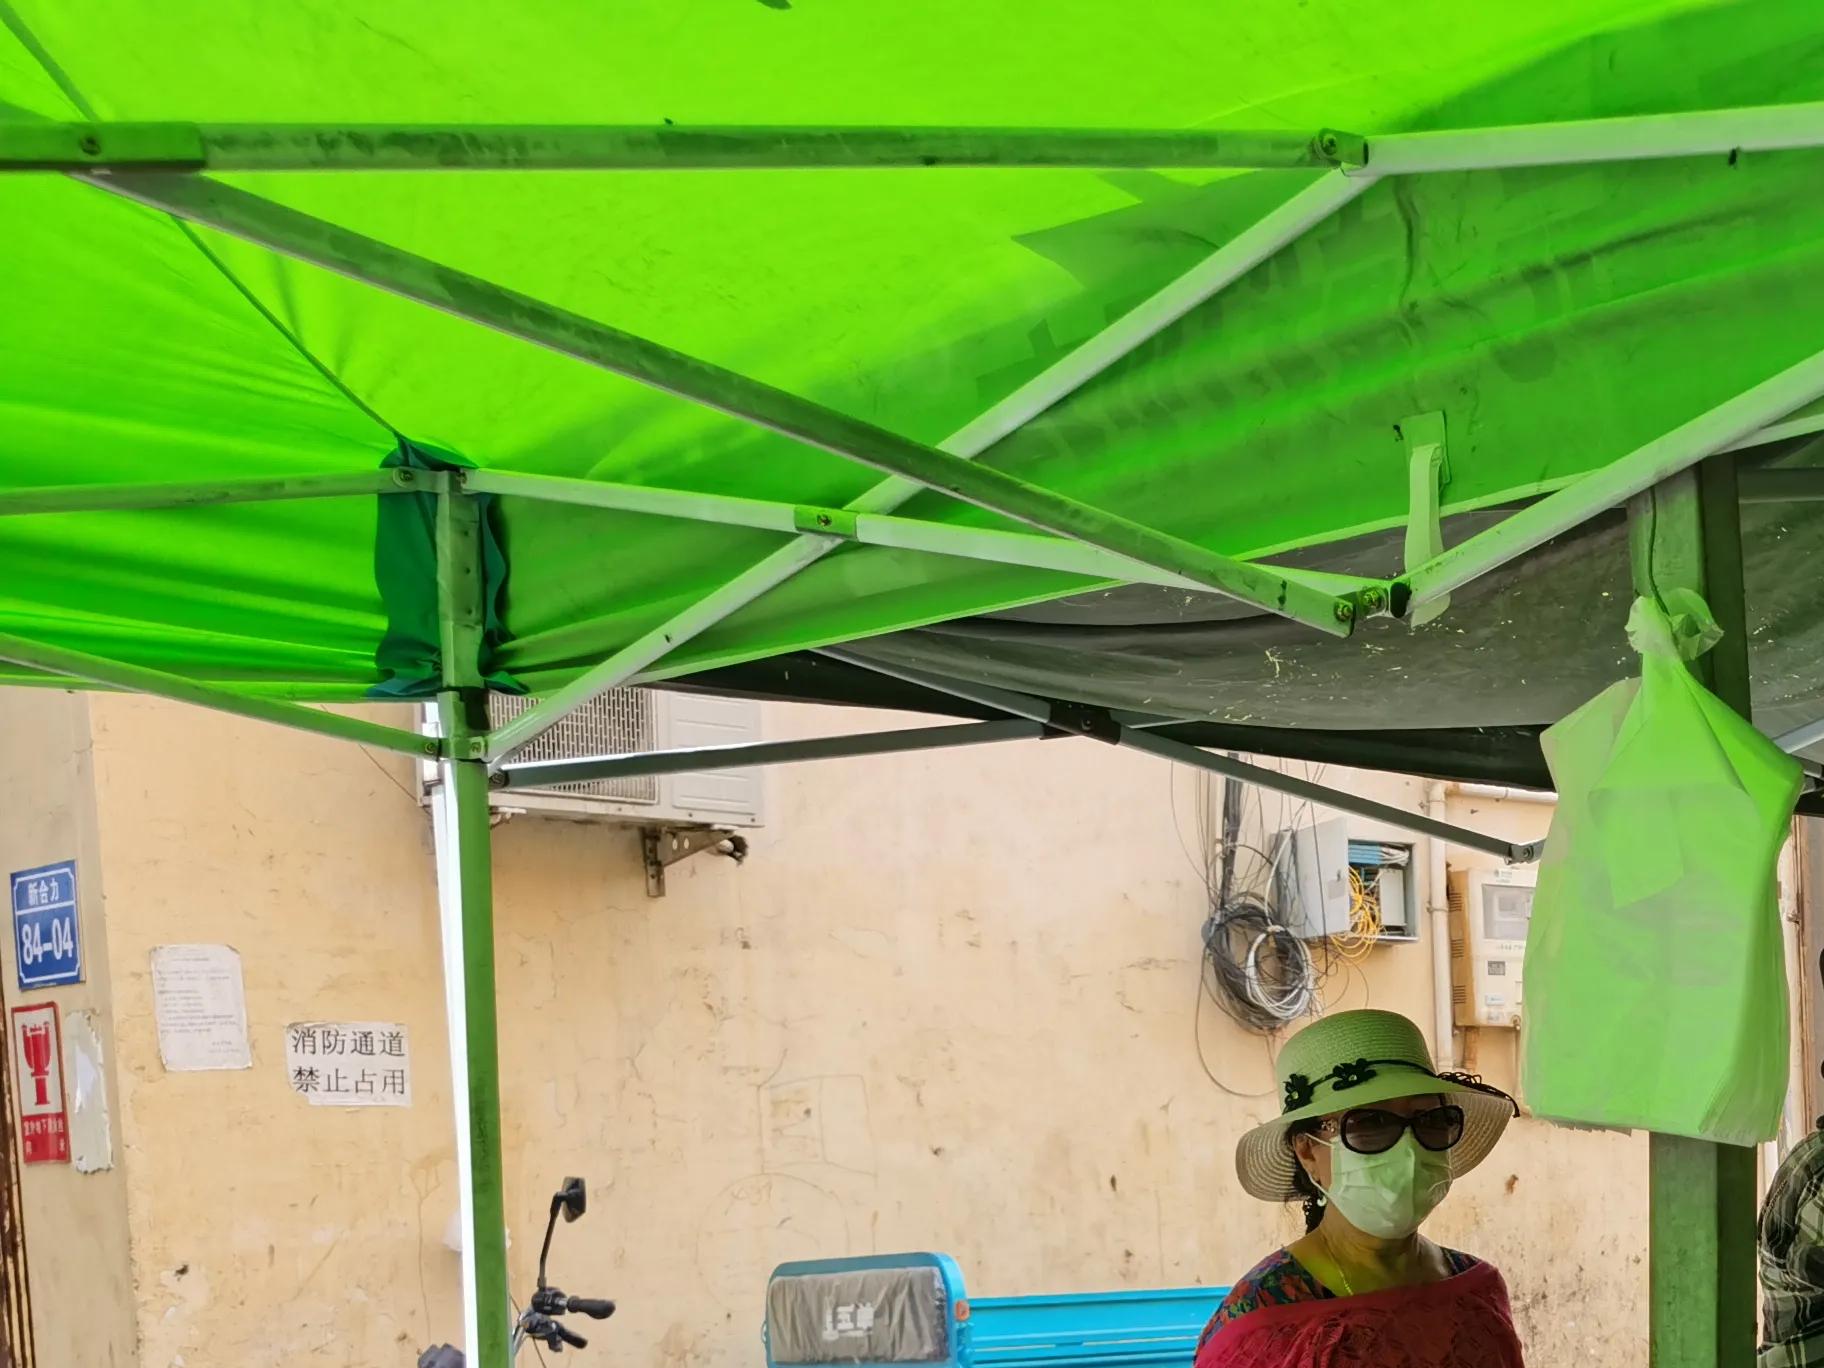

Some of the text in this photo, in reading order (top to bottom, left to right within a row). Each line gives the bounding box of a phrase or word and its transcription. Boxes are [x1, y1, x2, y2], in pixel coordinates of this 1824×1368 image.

[28, 878, 60, 906] 新合力
[22, 917, 74, 965] 84-04
[291, 1028, 405, 1057] 消防通道
[292, 1066, 406, 1095] 禁止占用
